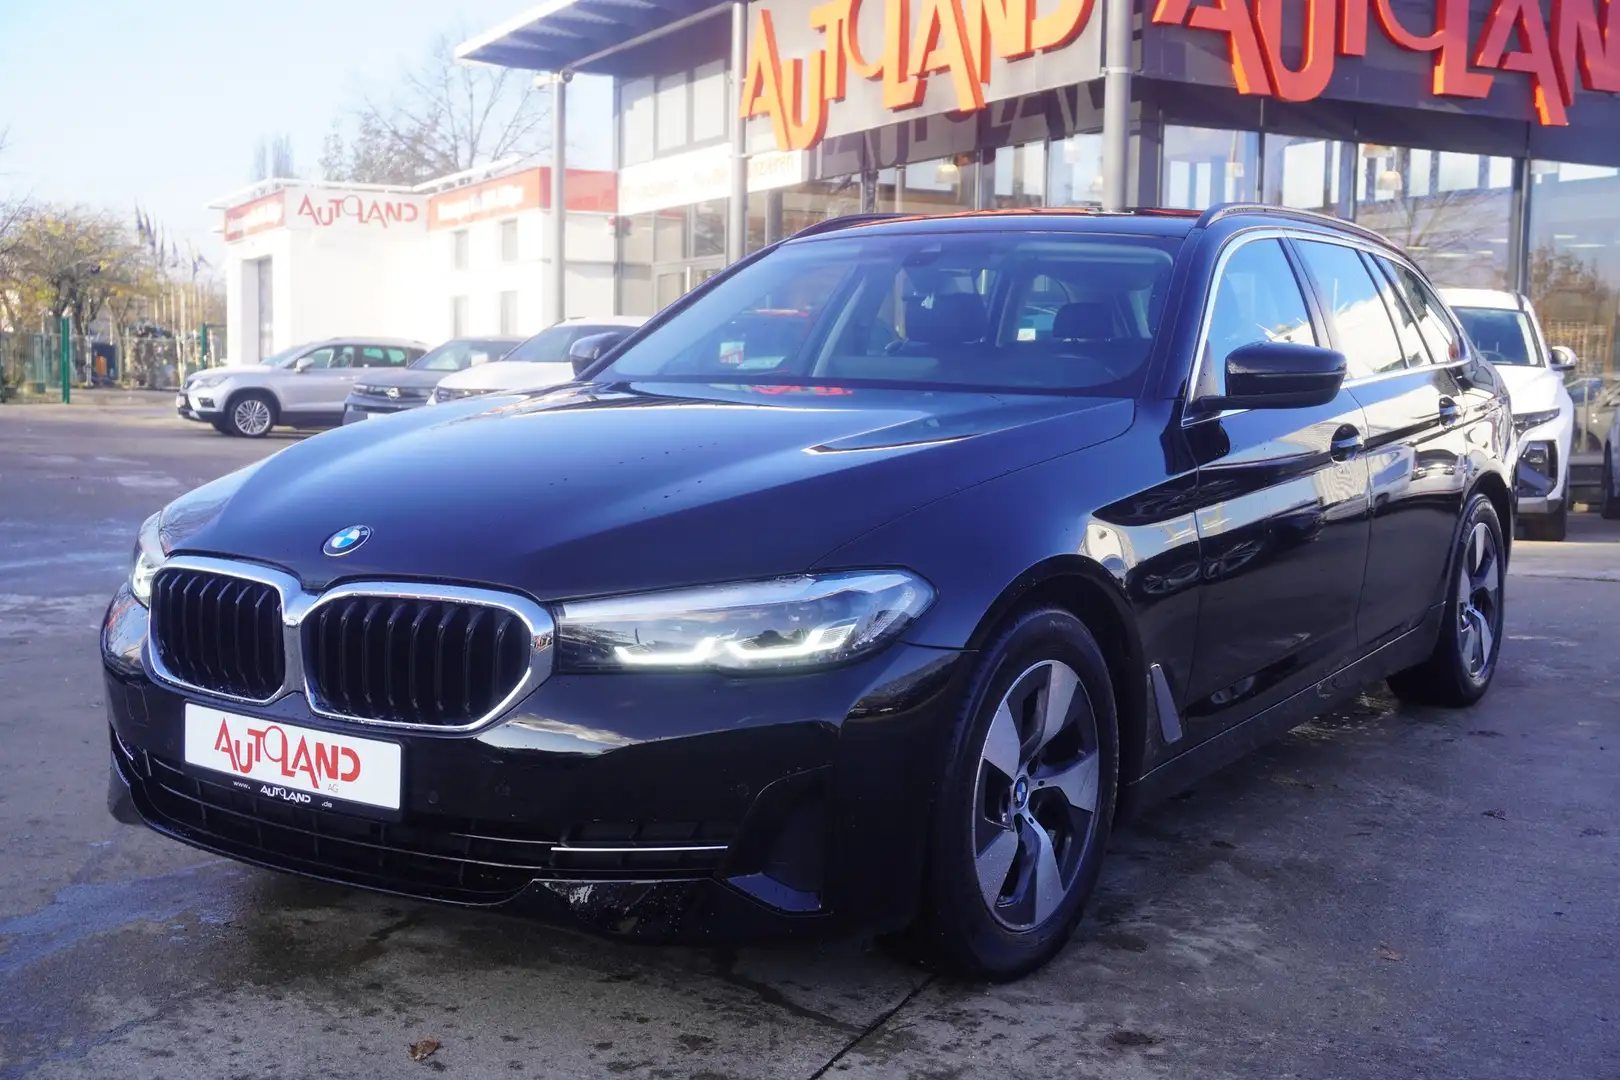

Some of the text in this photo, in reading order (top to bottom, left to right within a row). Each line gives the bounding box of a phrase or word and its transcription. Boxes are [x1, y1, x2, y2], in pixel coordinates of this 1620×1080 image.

[297, 194, 418, 228] AUTOLAND
[214, 716, 361, 789] AUTOLAND
[232, 780, 251, 790] www.
[260, 785, 311, 803] AUTOLAND
[328, 783, 340, 793] AG
